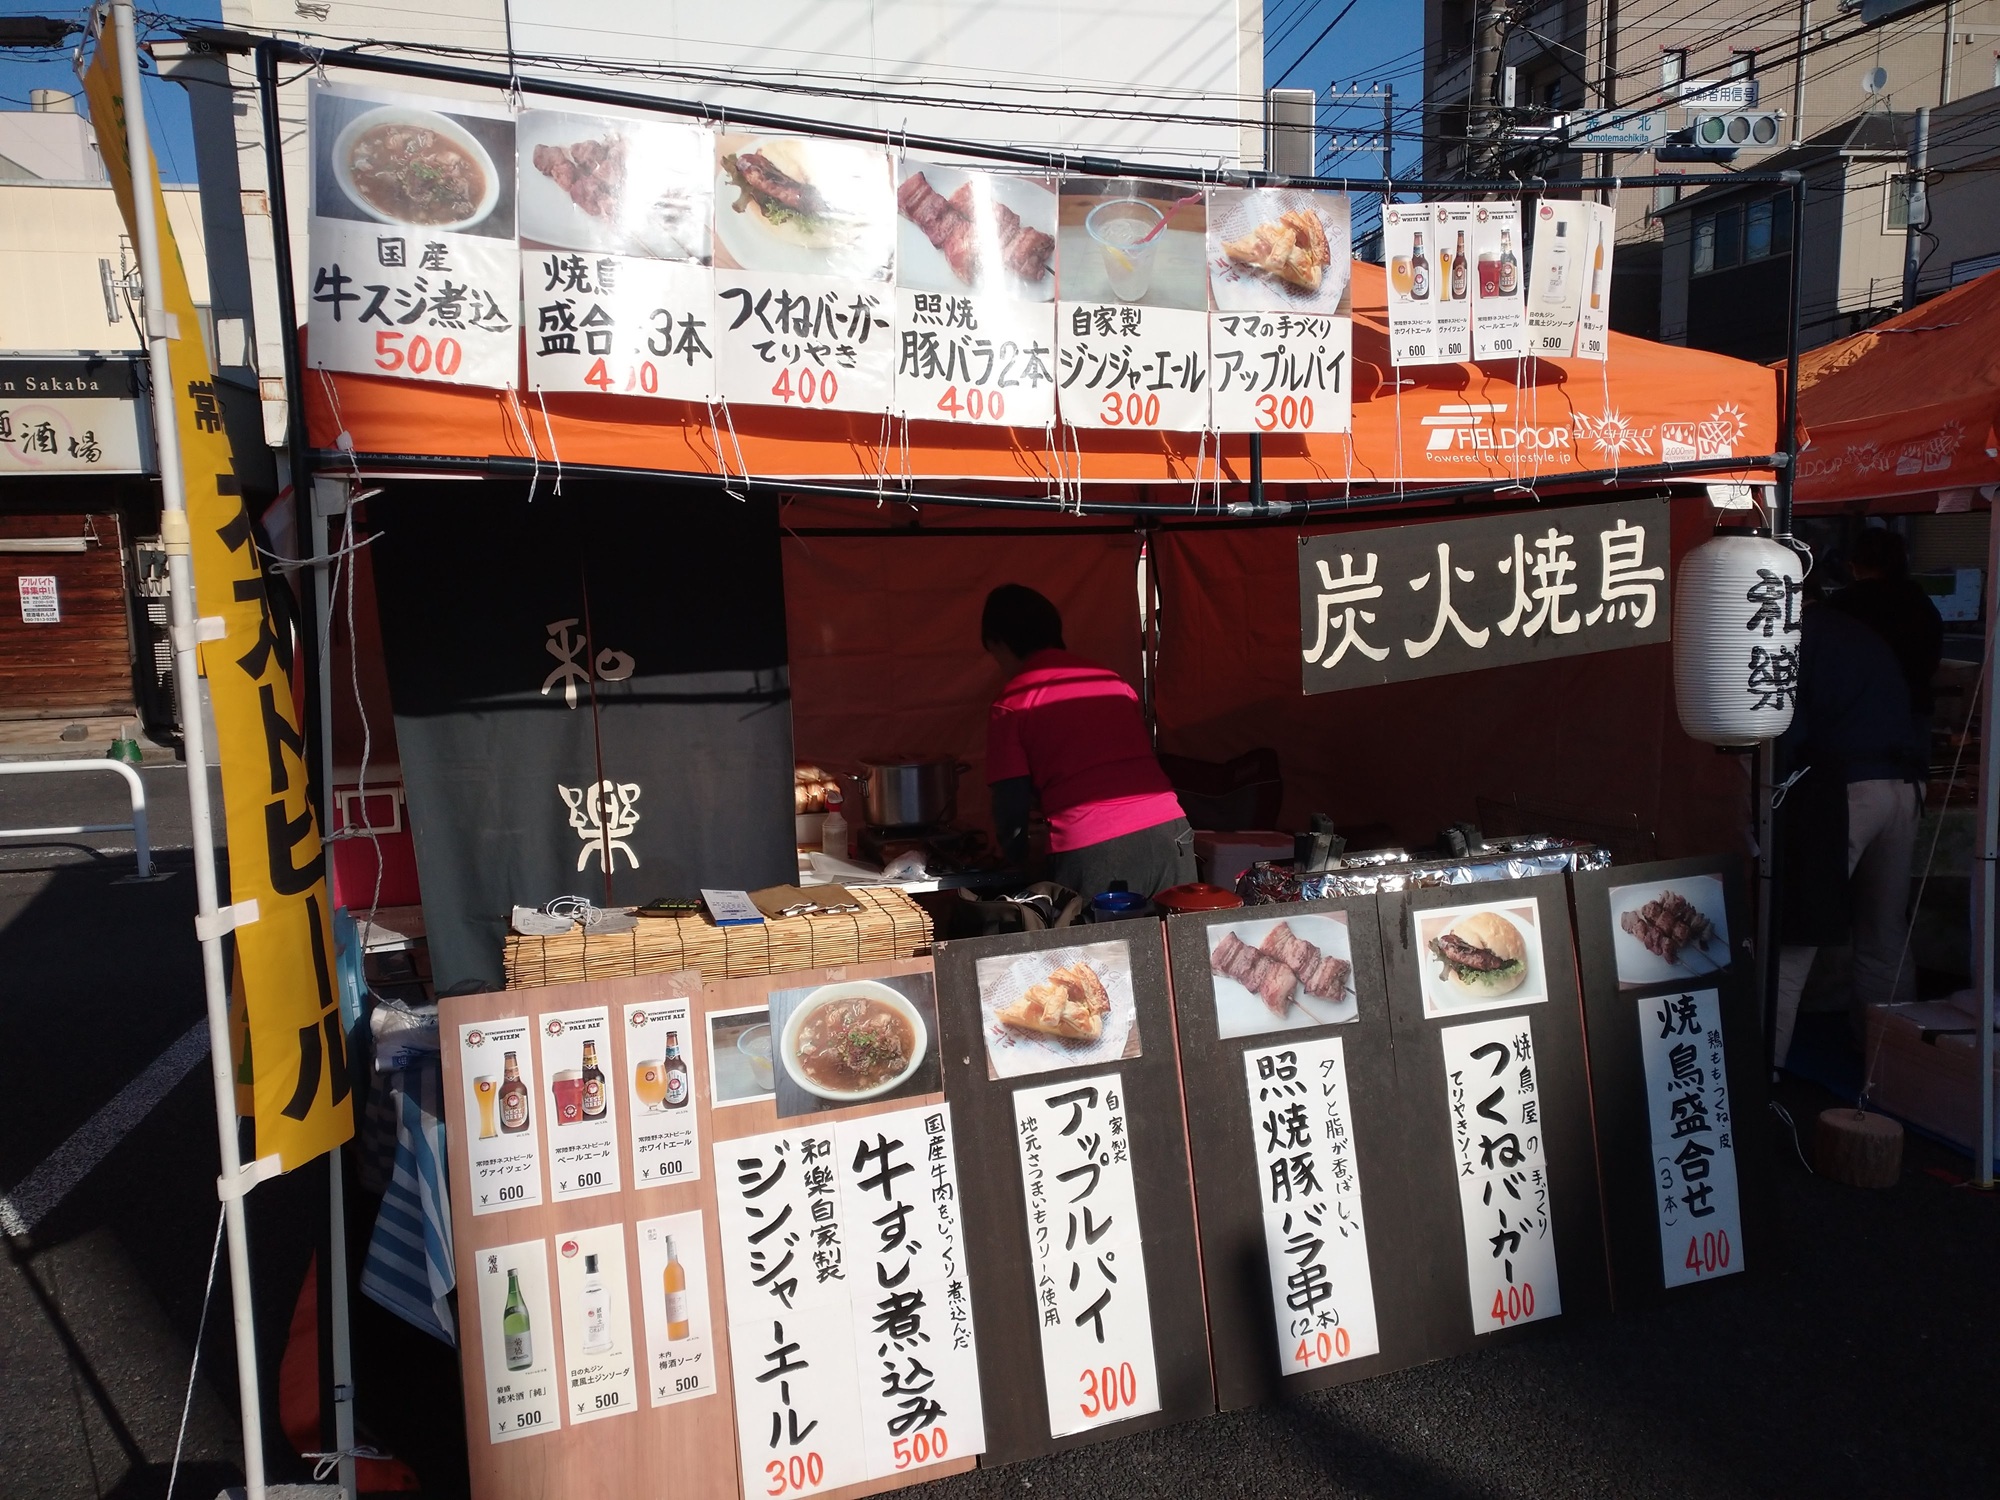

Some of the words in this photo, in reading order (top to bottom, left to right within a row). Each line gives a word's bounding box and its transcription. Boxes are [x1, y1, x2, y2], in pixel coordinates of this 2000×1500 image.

[1587, 133, 1649, 143] Omotemachikita
[377, 236, 453, 272] 国産
[313, 264, 512, 332] 牛スジ煮込
[718, 287, 889, 344] つくねバーガー
[912, 293, 978, 331] 照焼
[1072, 305, 1142, 338] 自家製
[1219, 314, 1332, 340] ママの手づくり
[374, 330, 462, 376] 500
[752, 340, 857, 369] てりやき
[899, 330, 1054, 389] 豚バラ2本
[1408, 345, 1426, 356] 600
[1448, 343, 1462, 355] 600
[1494, 339, 1513, 350] 600
[1542, 337, 1562, 348] 500
[1588, 340, 1600, 351] 500
[26, 377, 99, 391] Sakaba
[1060, 341, 1206, 393] ジンジャーエール
[1214, 345, 1345, 393] アップルパイ
[772, 367, 838, 405] 400
[937, 385, 1005, 421] 400
[1100, 391, 1160, 427] 300
[1254, 394, 1314, 431] 300
[1426, 452, 1479, 463] Powered
[1485, 452, 1499, 464] by
[1702, 441, 1722, 454] UV
[1303, 518, 1666, 669] 炭火焼鳥
[650, 1014, 672, 1022] WHITE
[492, 1033, 520, 1041] WEIZEN
[1450, 1070, 1475, 1177] てりやきソース
[1657, 994, 1716, 1219] 焼鳥盛合せ
[1105, 1090, 1128, 1164] 自家製
[1512, 1032, 1548, 1239] 焼鳥屋の手づくり
[557, 1149, 611, 1164] ペールエール
[639, 1138, 692, 1153] ホワイトエール
[1319, 1059, 1360, 1238] タレと脂が香ばしい
[1470, 1041, 1533, 1284] つくねバーガー
[480, 1162, 532, 1178] ヴァイツェン
[578, 1171, 601, 1187] 600
[659, 1160, 683, 1176] 600
[1257, 1050, 1333, 1317] 照焼豚バラ串
[499, 1185, 524, 1201] 600
[1020, 1116, 1062, 1328] 地元さつまいもクリーム使用
[1045, 1086, 1117, 1344] アップルパイ
[1686, 1228, 1731, 1277] 400
[737, 1138, 818, 1449] ジンジャーエール
[852, 1132, 948, 1437] 牛すじ煮込み
[1491, 1283, 1535, 1326] 400
[1295, 1327, 1351, 1369] 400
[571, 1365, 603, 1377] 日の丸ジン
[675, 1375, 699, 1392] 500
[595, 1392, 619, 1409] 500
[1079, 1362, 1137, 1418] 300
[517, 1410, 542, 1427] 500
[893, 1427, 949, 1470] 500
[765, 1452, 824, 1497] 300
